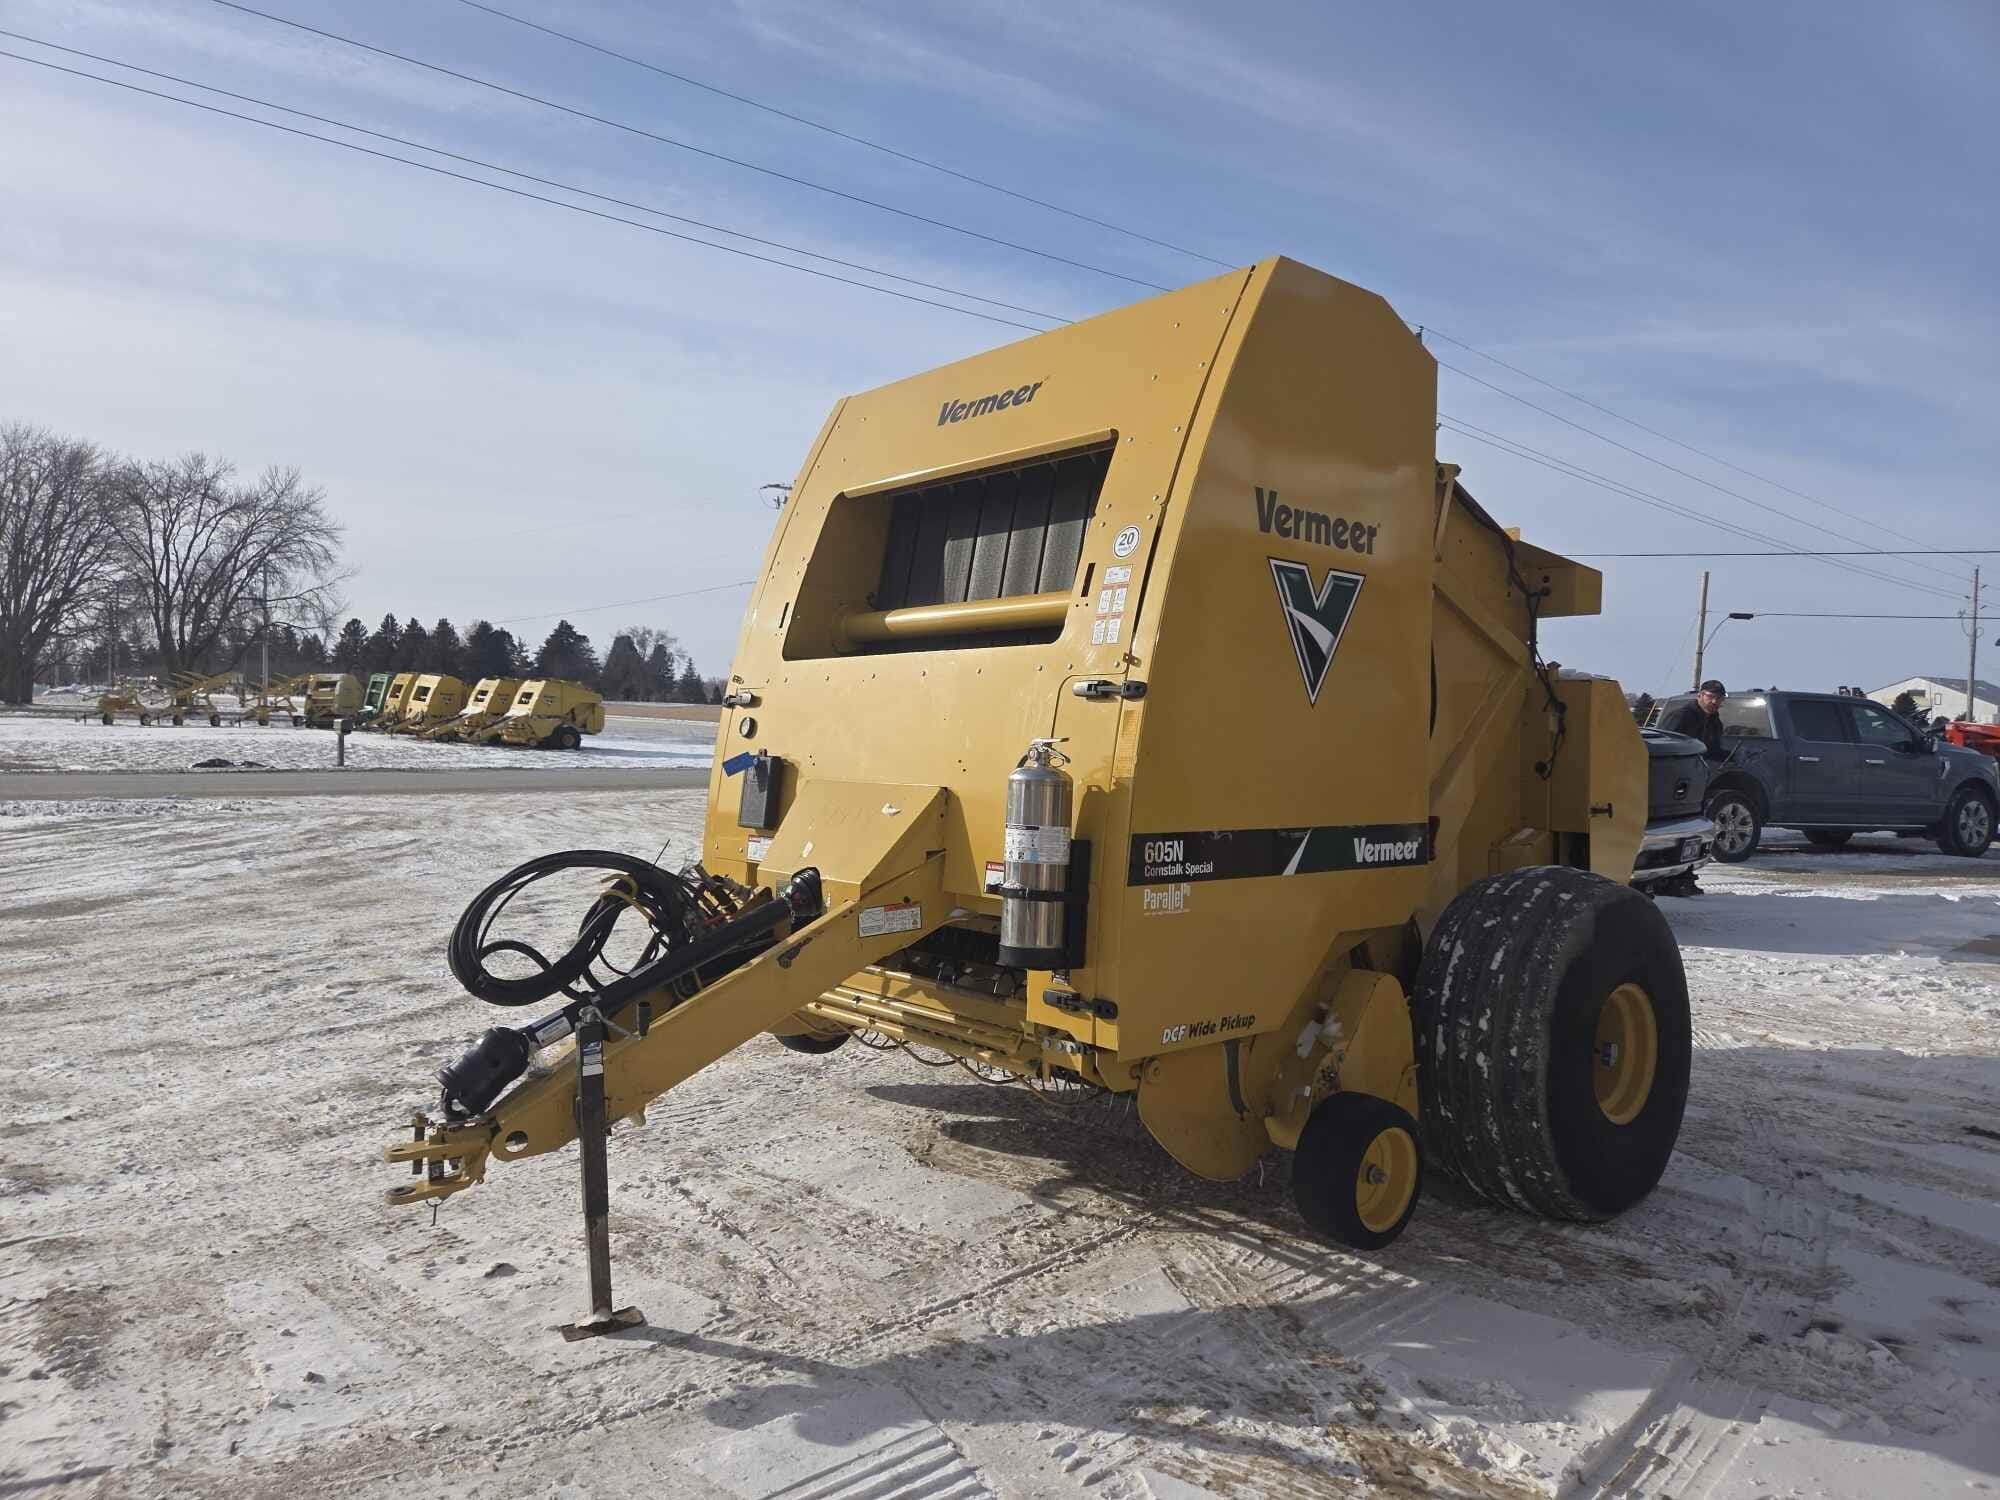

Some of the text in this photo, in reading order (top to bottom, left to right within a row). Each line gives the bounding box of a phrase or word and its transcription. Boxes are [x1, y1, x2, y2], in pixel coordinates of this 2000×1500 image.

[937, 381, 1044, 426] Vermeer
[1255, 486, 1378, 555] Vermeer
[1118, 532, 1135, 546] 20
[1144, 839, 1184, 864] 605N
[1353, 837, 1419, 863] Vermeer
[1144, 860, 1213, 877] Cornstalk Special
[1143, 883, 1184, 910] Parallel
[1188, 1020, 1217, 1038] Wide
[1219, 1014, 1256, 1032] Pickup
